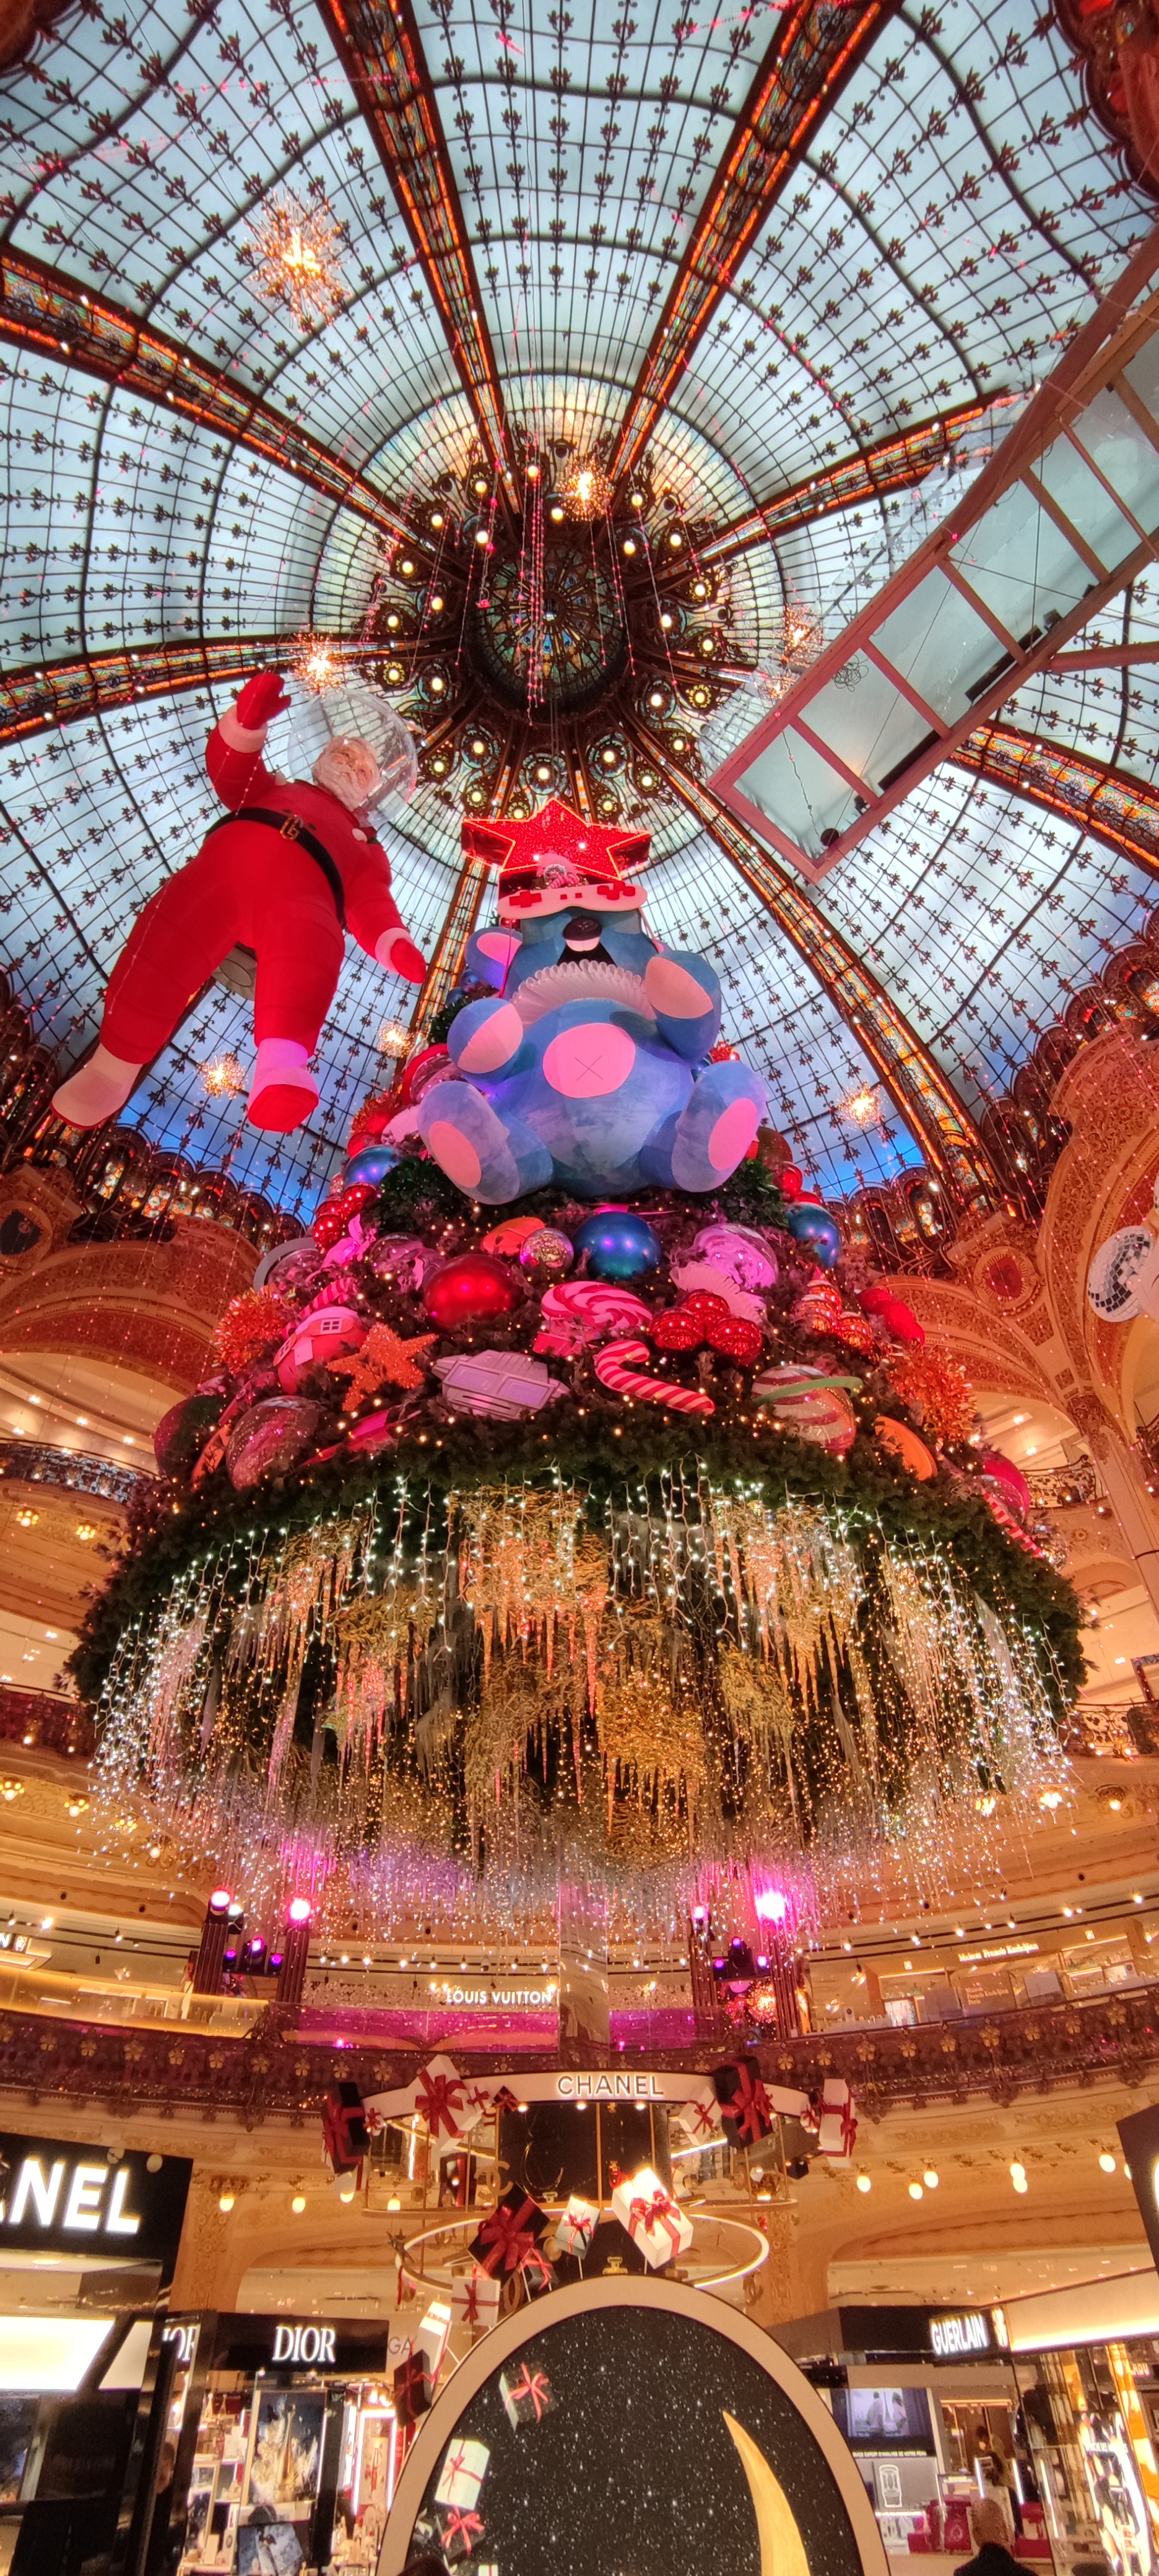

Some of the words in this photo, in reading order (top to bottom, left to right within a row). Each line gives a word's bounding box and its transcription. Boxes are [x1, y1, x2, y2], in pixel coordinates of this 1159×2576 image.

[958, 1952, 982, 1962] Maison
[983, 1947, 1007, 1958] Francis
[446, 1990, 487, 2004] LOUIS
[492, 1990, 552, 2004] VUITTON
[557, 2074, 664, 2096] CHANEL
[0, 2159, 141, 2234] NEL
[272, 2326, 336, 2363] DIOR
[931, 2313, 988, 2356] GUERLAIN
